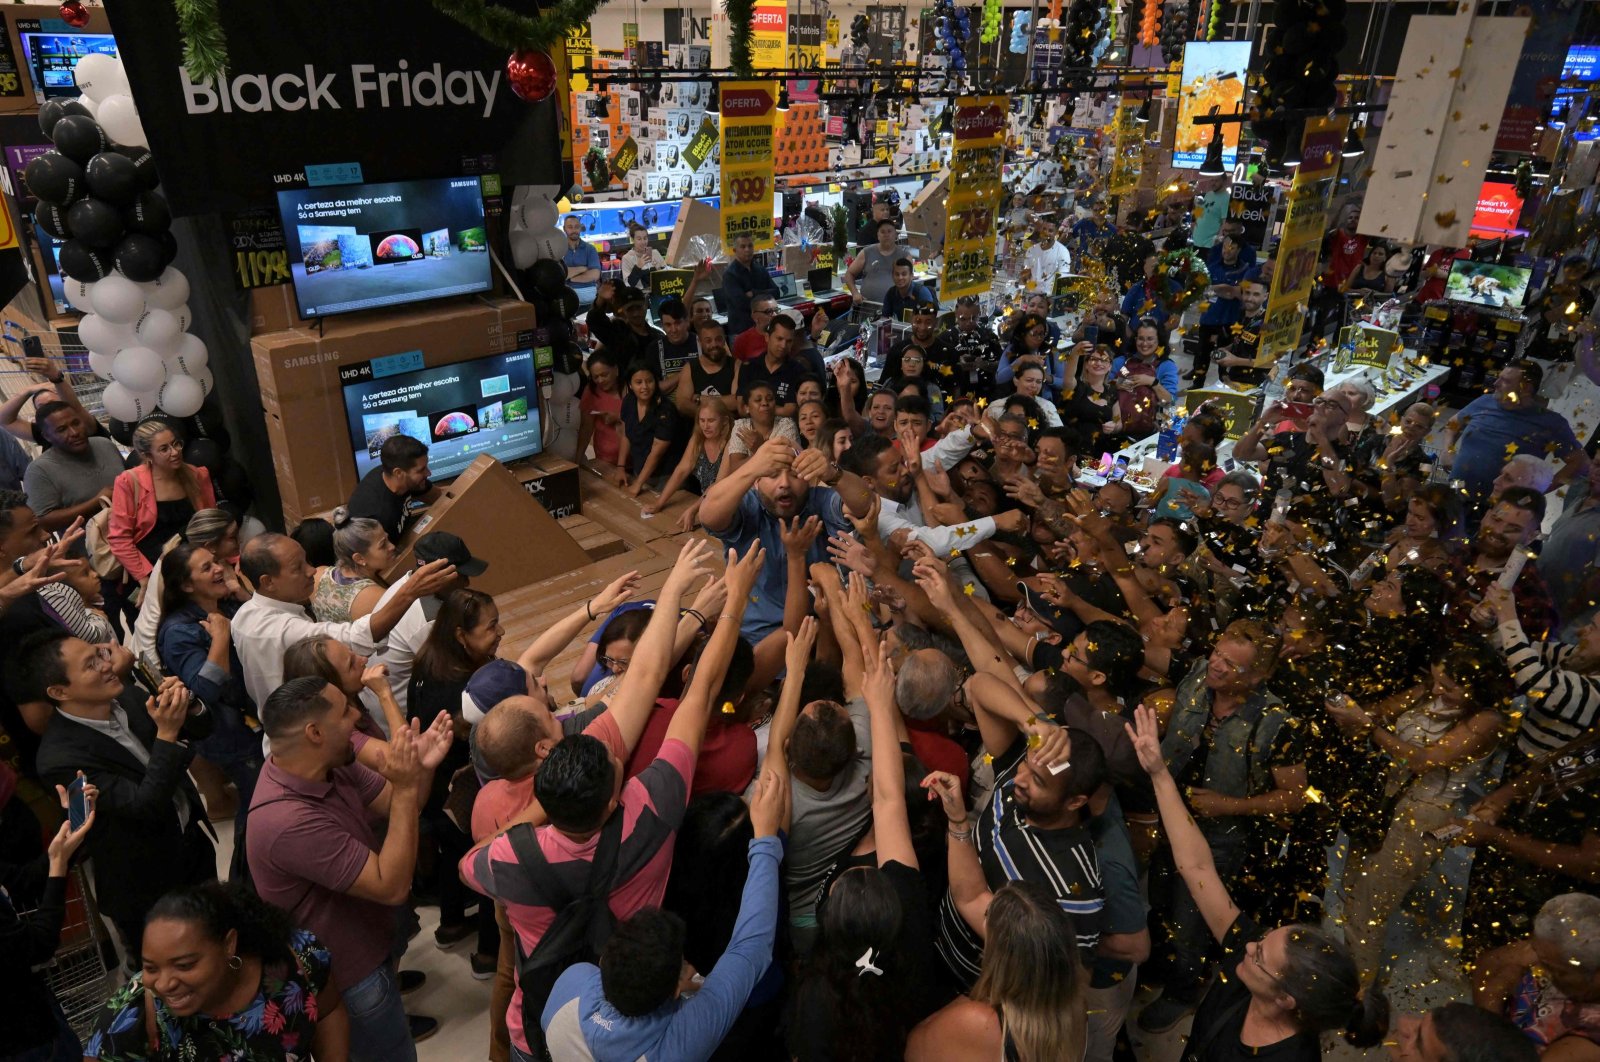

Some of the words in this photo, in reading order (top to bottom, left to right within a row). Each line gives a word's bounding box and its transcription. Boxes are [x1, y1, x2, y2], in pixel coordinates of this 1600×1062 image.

[178, 63, 342, 115] Black
[351, 58, 502, 118] Friday
[724, 98, 762, 109] OFERTA
[691, 132, 708, 156] Black
[697, 136, 713, 161] Friday
[725, 140, 745, 149] ATOM
[273, 174, 292, 183] UHD
[293, 173, 306, 182] 4K
[450, 179, 478, 188] SAMSUNG
[1232, 185, 1270, 202] Black
[297, 203, 303, 211] A
[304, 201, 334, 211] certeza
[335, 199, 346, 208] da
[346, 197, 373, 206] melhor
[373, 195, 402, 204] escolha
[1481, 199, 1499, 207] Smart
[298, 211, 308, 219] Só
[314, 208, 347, 218] Samsung
[347, 207, 361, 215] tem
[659, 276, 684, 291] Black
[283, 351, 341, 369] SAMSUNG
[505, 352, 531, 363] SAMSUNG
[341, 369, 359, 379] UHD
[360, 365, 371, 376] 4K
[361, 394, 368, 402] A
[368, 389, 397, 401] certeza
[397, 385, 408, 395] da
[408, 381, 432, 393] melhor
[433, 375, 460, 387] escolha
[362, 401, 372, 410] Só
[378, 395, 408, 407] Samsung
[408, 391, 422, 401] tem
